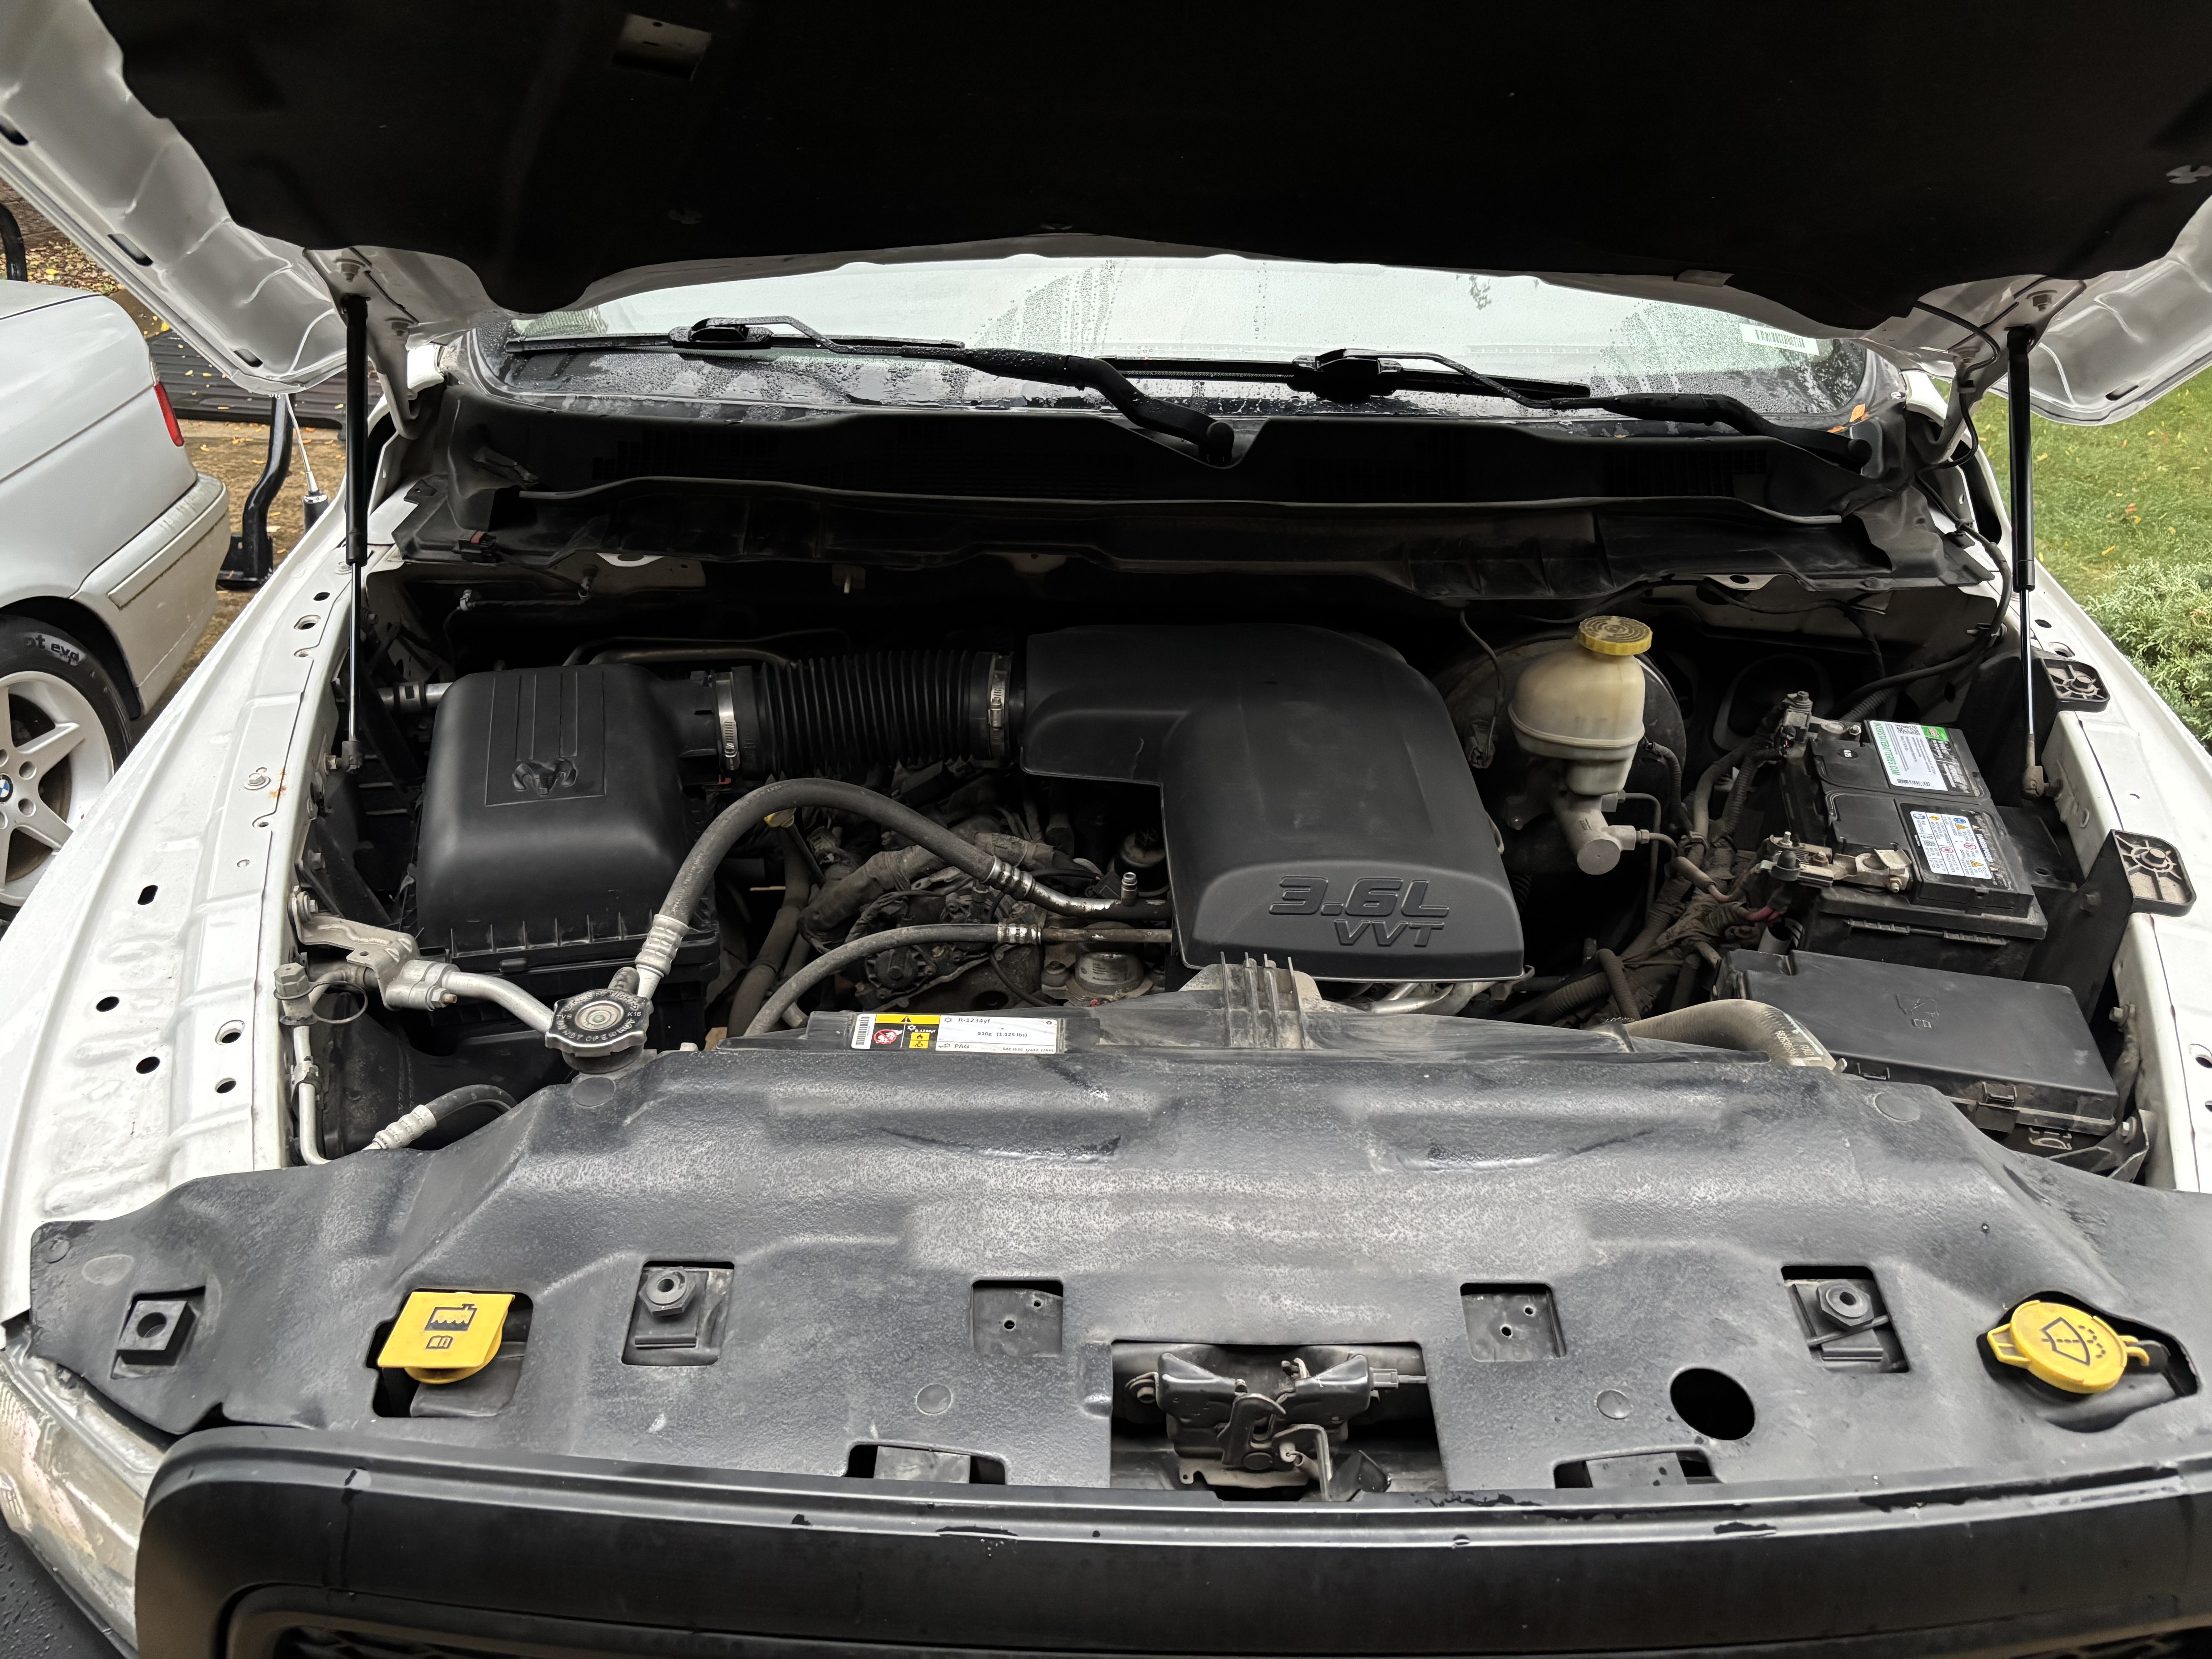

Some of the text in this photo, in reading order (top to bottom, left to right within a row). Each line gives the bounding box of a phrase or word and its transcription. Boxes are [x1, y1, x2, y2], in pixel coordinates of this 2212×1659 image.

[1976, 834, 1994, 862] DANGER POISON
[1269, 875, 1450, 918] 3.6L
[1333, 919, 1445, 947] VVT
[572, 990, 637, 1005] KEEP TIGHT
[563, 1030, 584, 1040] NOT
[586, 1032, 617, 1041] OPEN
[617, 1018, 636, 1034] HOT
[1799, 1045, 1814, 1056] RAD
